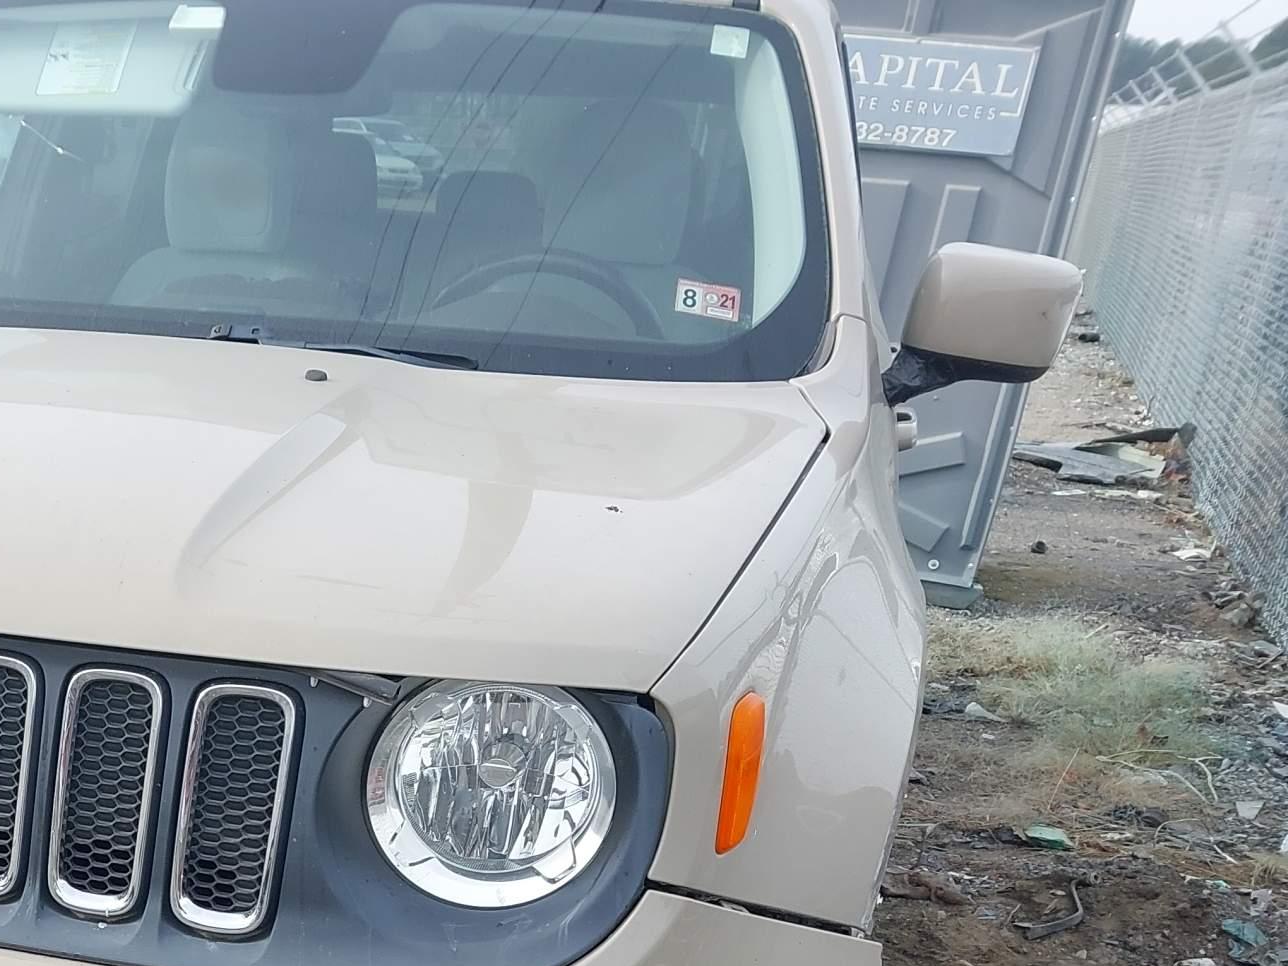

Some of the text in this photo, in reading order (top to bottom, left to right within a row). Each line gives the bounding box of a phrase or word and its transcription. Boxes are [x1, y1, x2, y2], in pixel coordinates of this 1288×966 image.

[849, 52, 1019, 98] APITAL
[858, 95, 996, 120] TE SERVICES
[855, 121, 958, 147] 32-8787
[682, 288, 736, 310] 8 21
